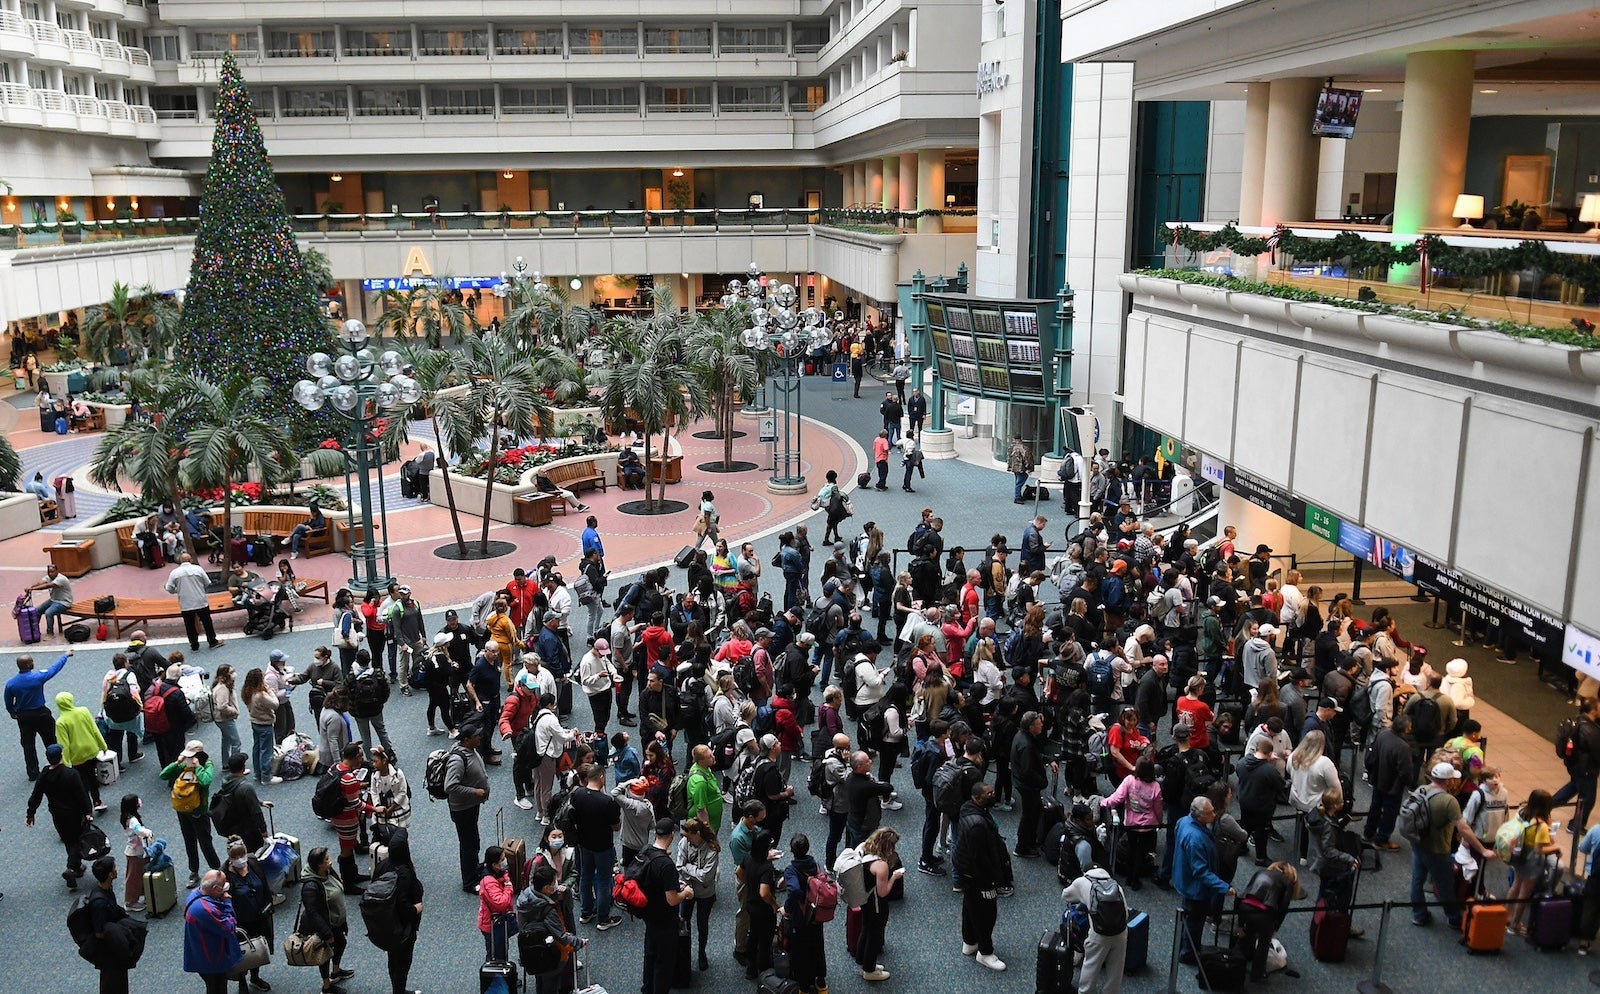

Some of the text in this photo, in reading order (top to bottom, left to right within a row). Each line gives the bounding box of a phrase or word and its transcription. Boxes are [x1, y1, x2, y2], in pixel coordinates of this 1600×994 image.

[403, 246, 432, 276] A
[1312, 523, 1330, 538] MINUTES
[1417, 555, 1437, 569] REMOVE
[1437, 565, 1446, 574] ALL
[1482, 584, 1504, 602] LARGER
[1505, 596, 1522, 610] THAN
[1523, 603, 1540, 619] YOUR
[1541, 613, 1564, 630] PHONE
[1436, 574, 1533, 628] AND PLACE IN A BIN FOR SCREENING
[1460, 601, 1478, 616] GATES
[1478, 609, 1486, 620] 70
[1490, 615, 1500, 627] 129
[1523, 626, 1546, 643] Thank you!
